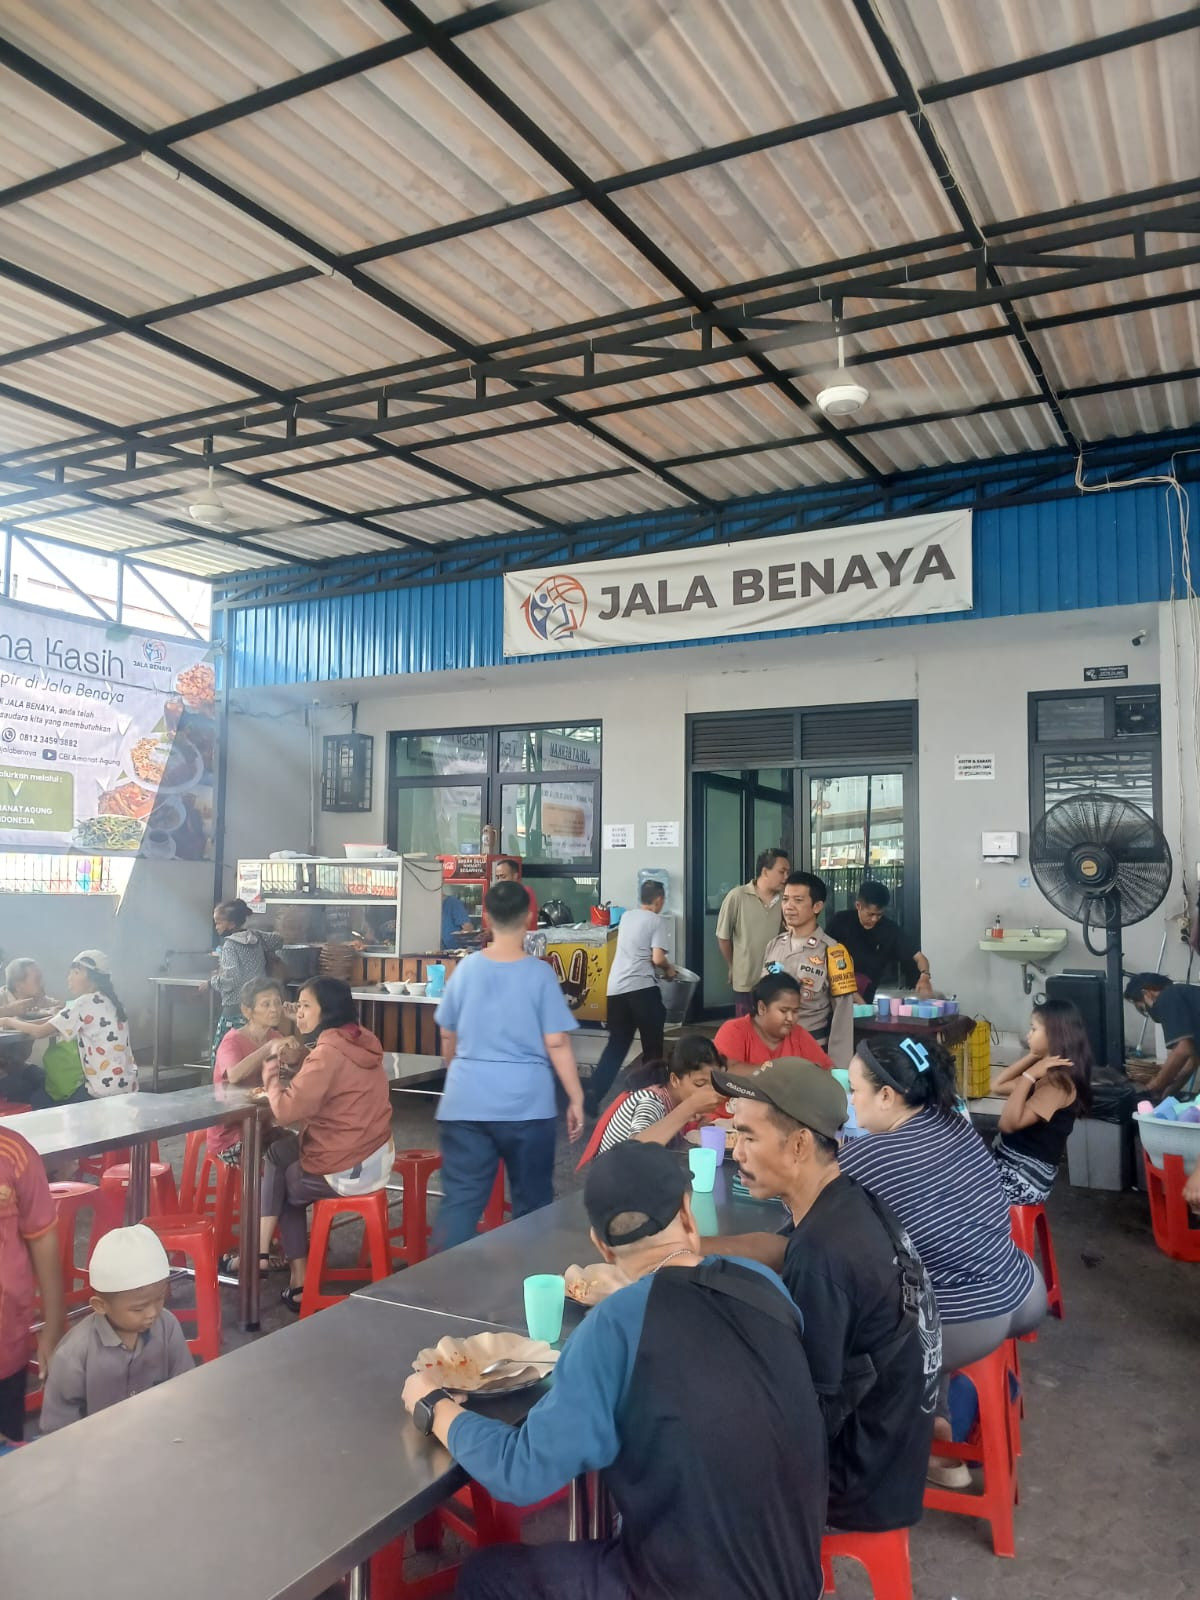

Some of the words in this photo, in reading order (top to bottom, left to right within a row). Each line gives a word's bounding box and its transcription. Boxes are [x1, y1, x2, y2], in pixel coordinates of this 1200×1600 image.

[597, 574, 718, 620] JALA
[732, 544, 956, 606] BENAYA
[46, 637, 124, 679] Kasih
[25, 674, 39, 689] di
[41, 678, 71, 695] Jala
[76, 682, 124, 705] Benaya
[5, 699, 24, 709] JALA
[30, 714, 43, 724] kita
[45, 717, 61, 727] yang
[62, 721, 111, 733] membutuhkan
[0, 804, 23, 813] ANAT
[24, 806, 53, 815] AGUNG
[0, 815, 35, 825] DONESIA
[800, 964, 824, 977] POLRI
[726, 1081, 756, 1097] DIADORA
